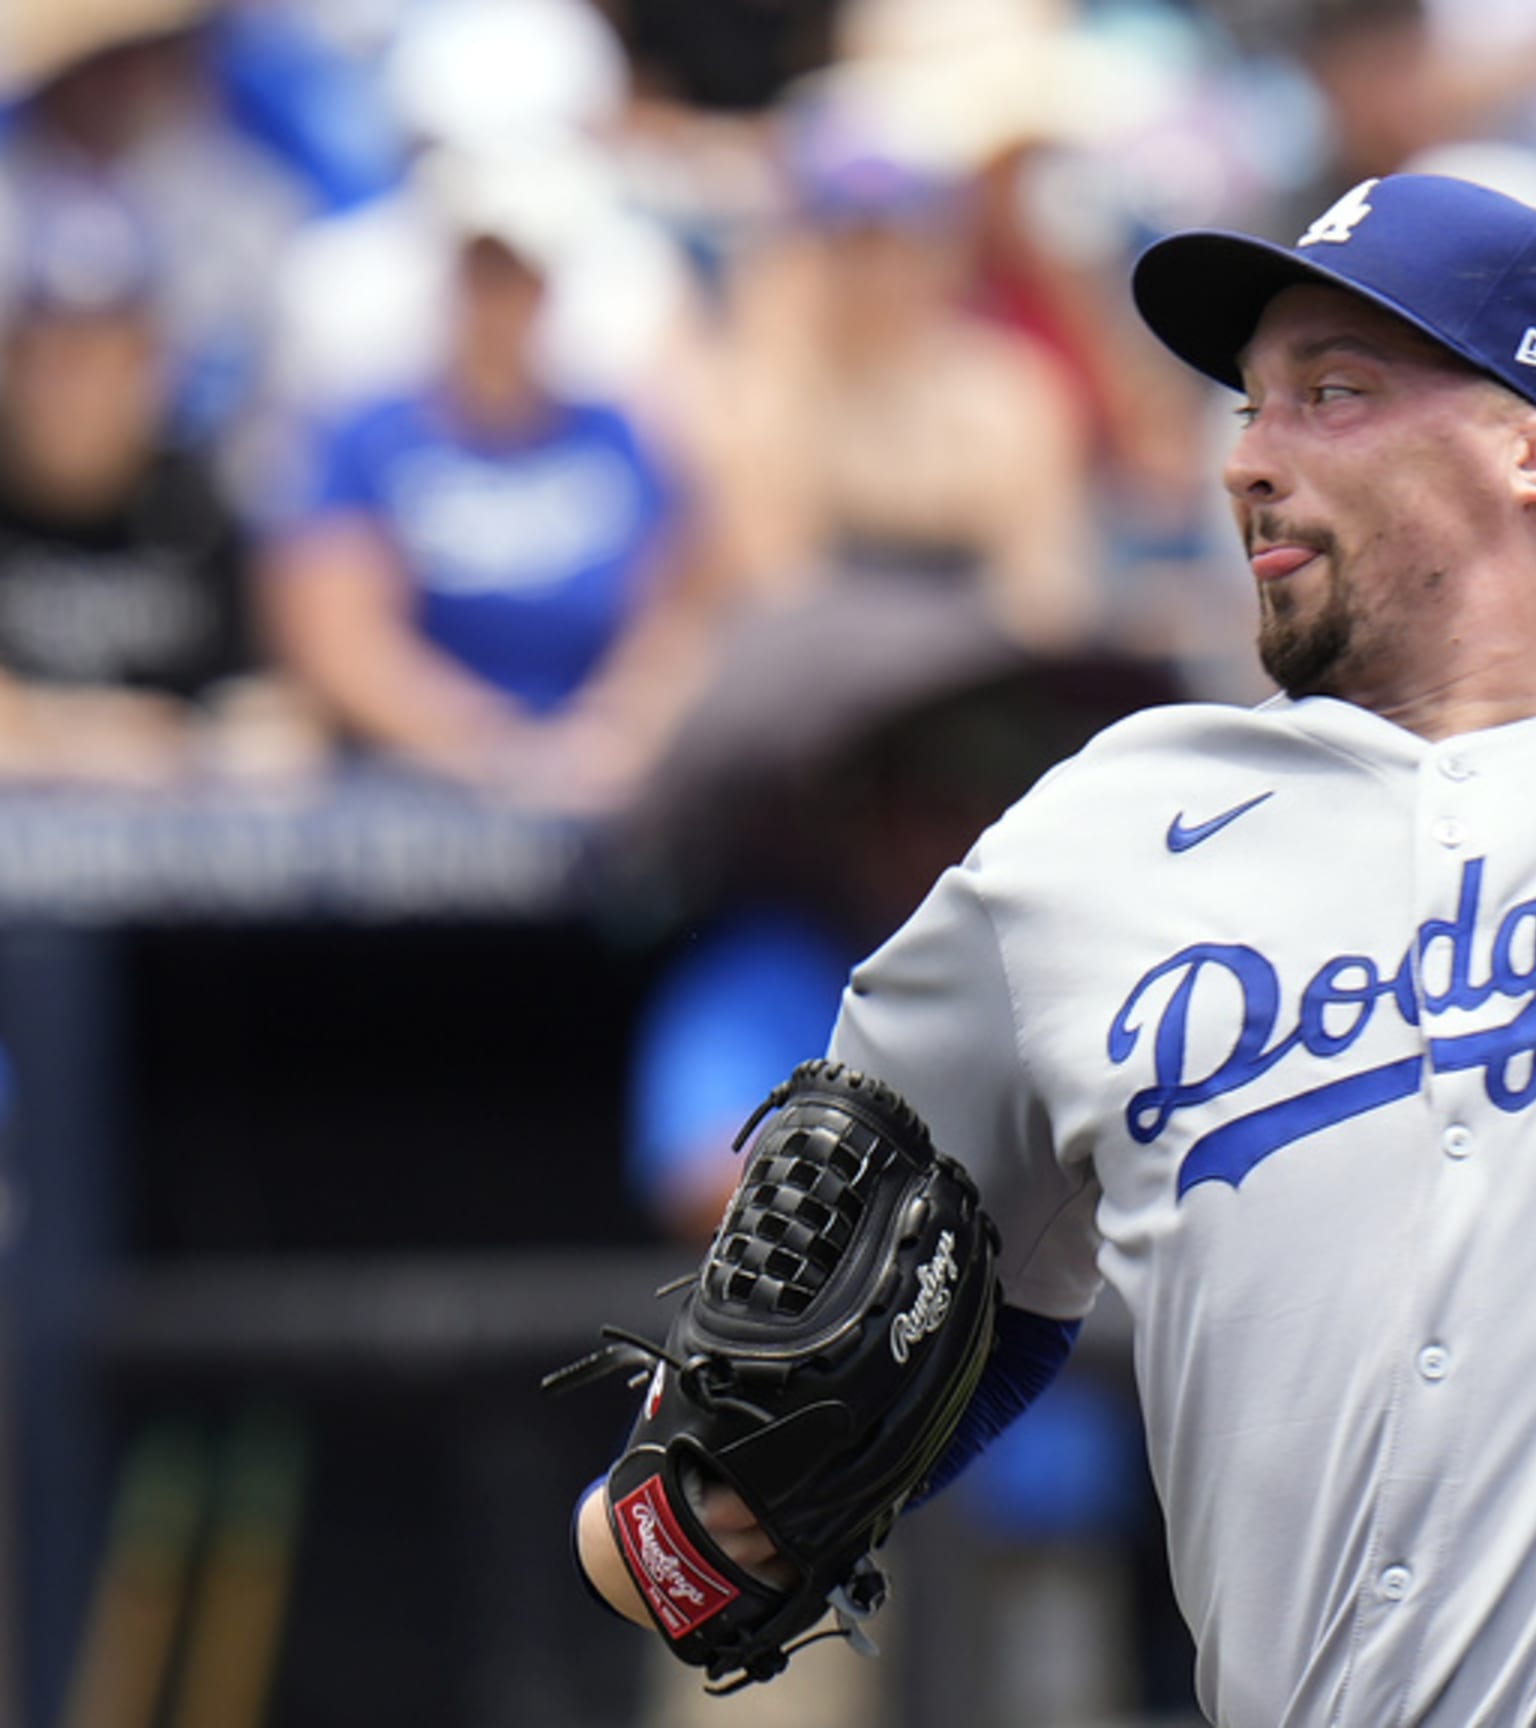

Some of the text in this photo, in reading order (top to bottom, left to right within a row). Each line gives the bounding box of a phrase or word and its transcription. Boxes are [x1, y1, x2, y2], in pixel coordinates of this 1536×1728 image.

[1296, 178, 1381, 248] LA
[890, 1229, 958, 1363] Rawlings
[632, 1502, 704, 1606] Rawlings
